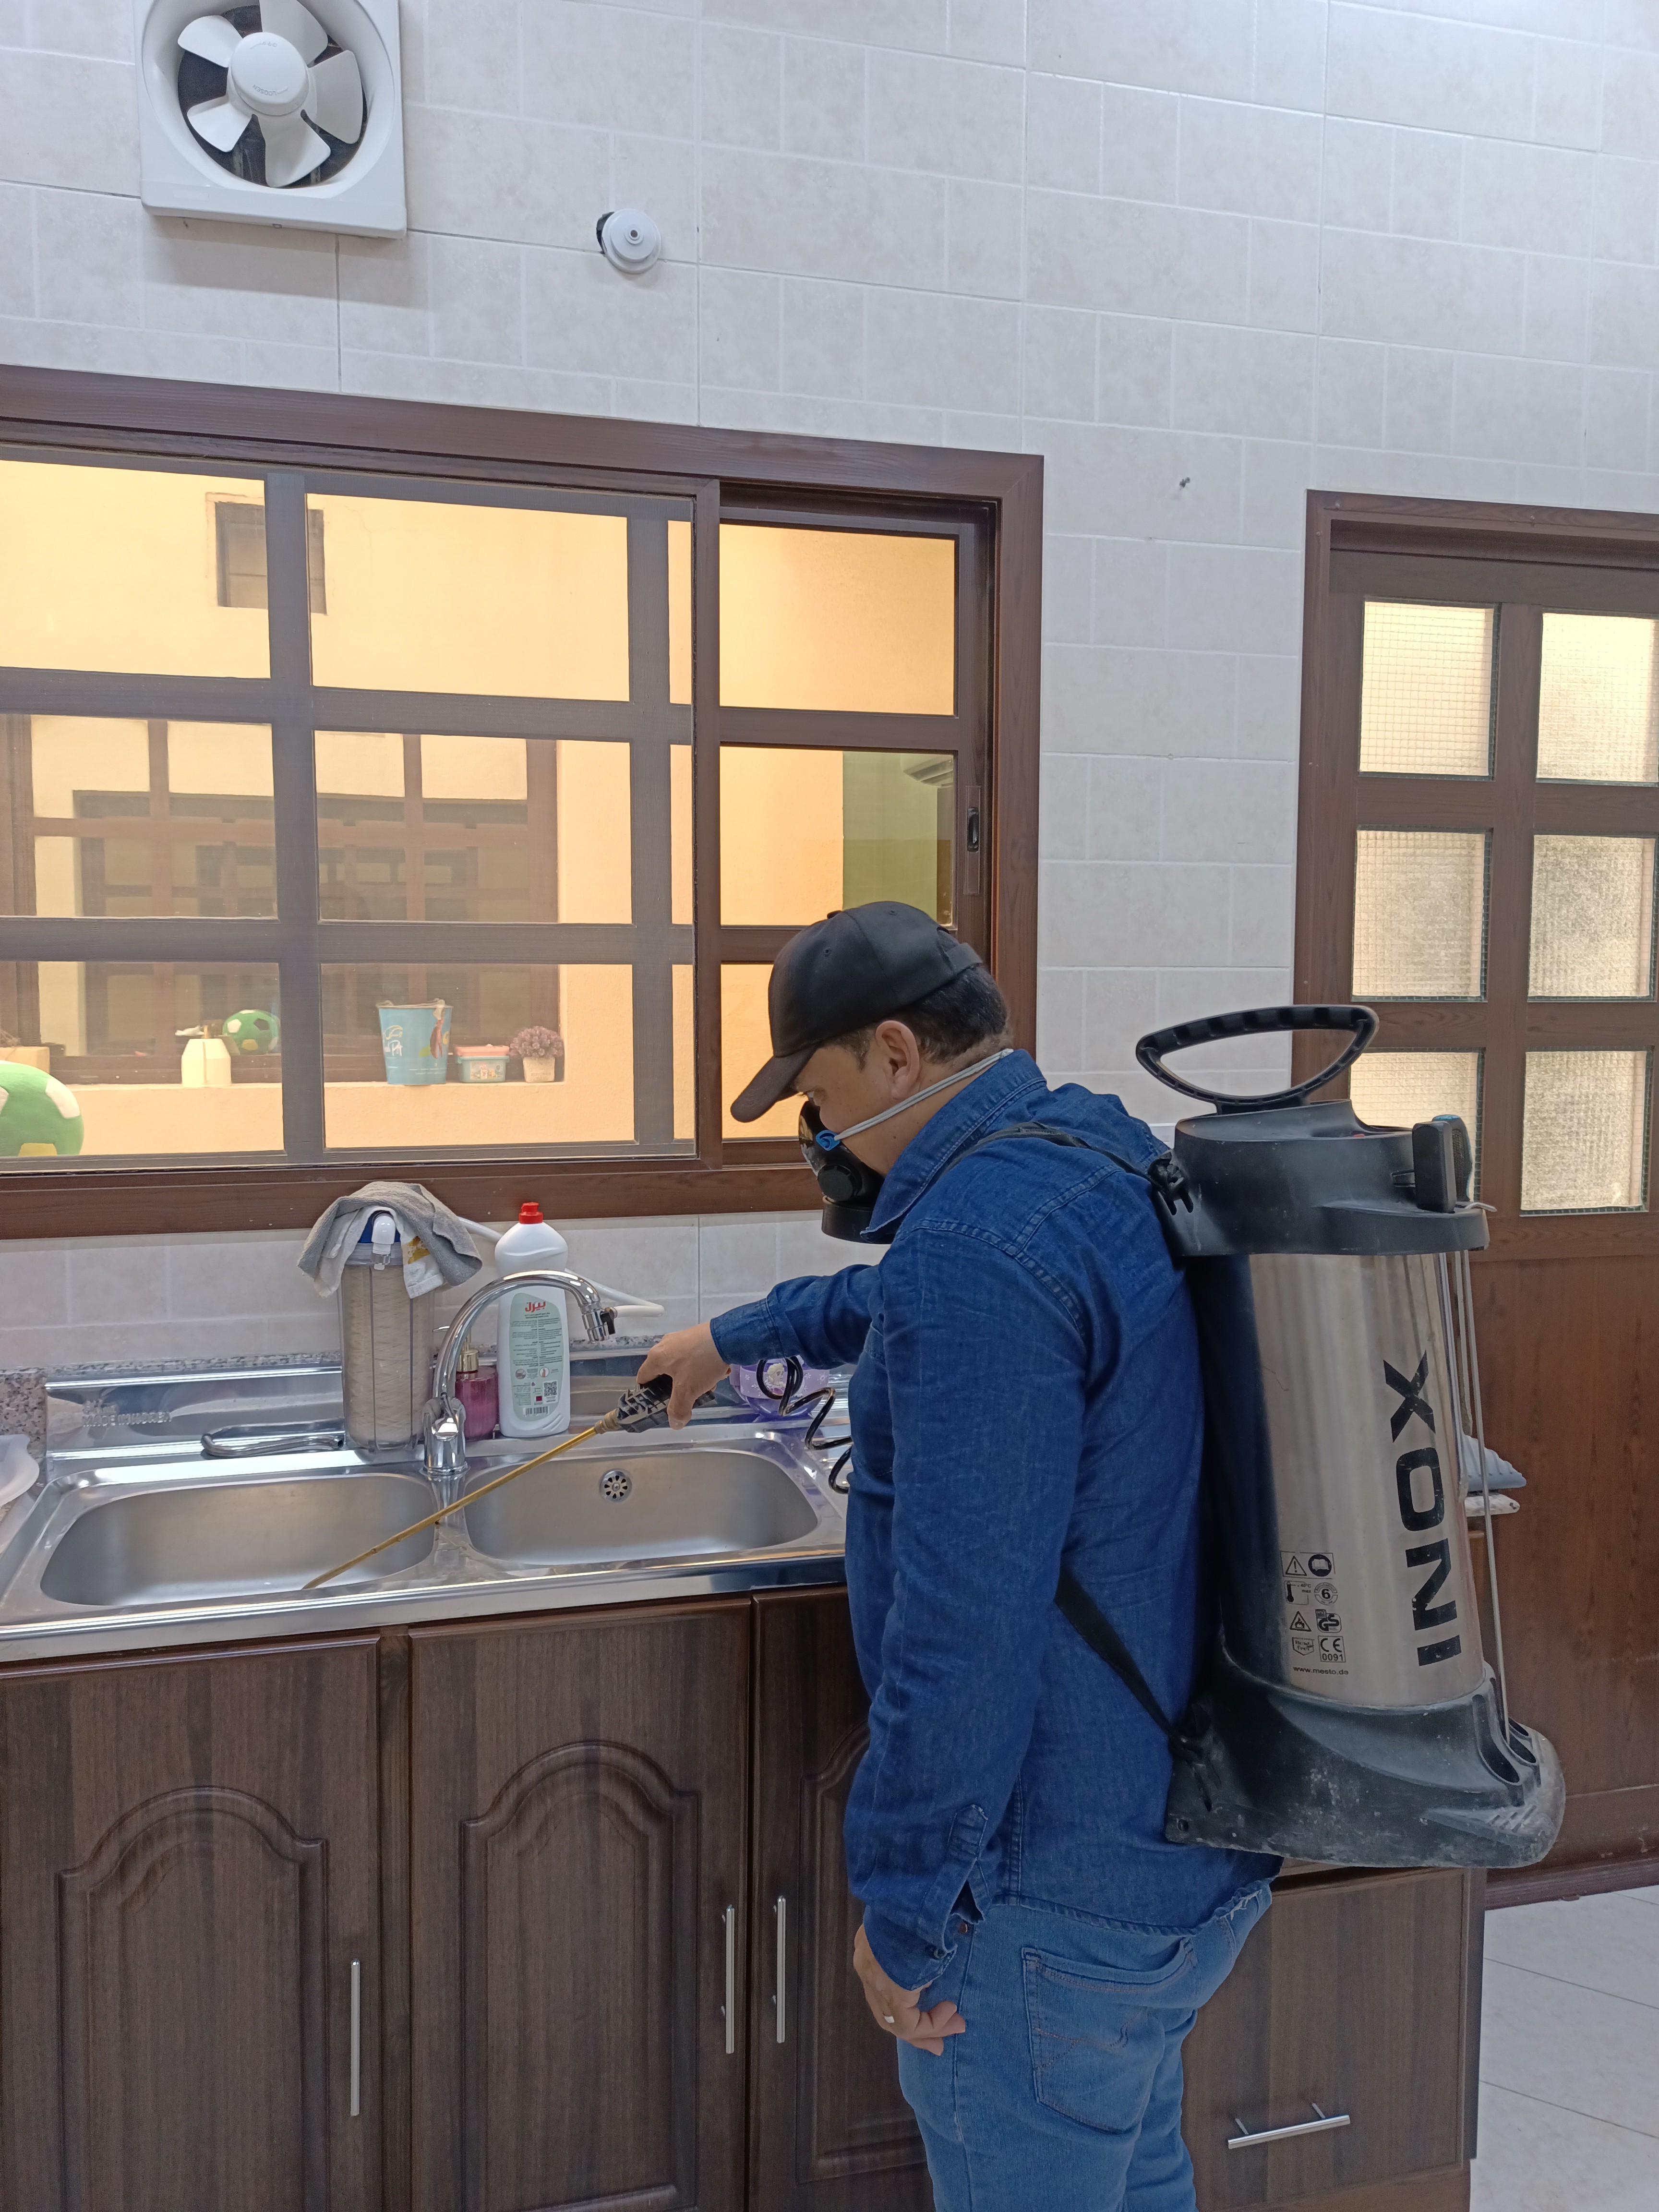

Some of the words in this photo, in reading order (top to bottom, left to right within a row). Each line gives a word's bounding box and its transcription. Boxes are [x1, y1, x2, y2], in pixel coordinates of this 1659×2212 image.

[83, 1415, 116, 1427] MADE
[117, 1414, 130, 1425] IN
[1383, 1349, 1462, 1667] INOX
[1321, 1588, 1331, 1599] 6
[1320, 1638, 1342, 1653] CE
[1322, 1653, 1343, 1661] 0091
[1293, 1666, 1349, 1675] www.mesto.de
